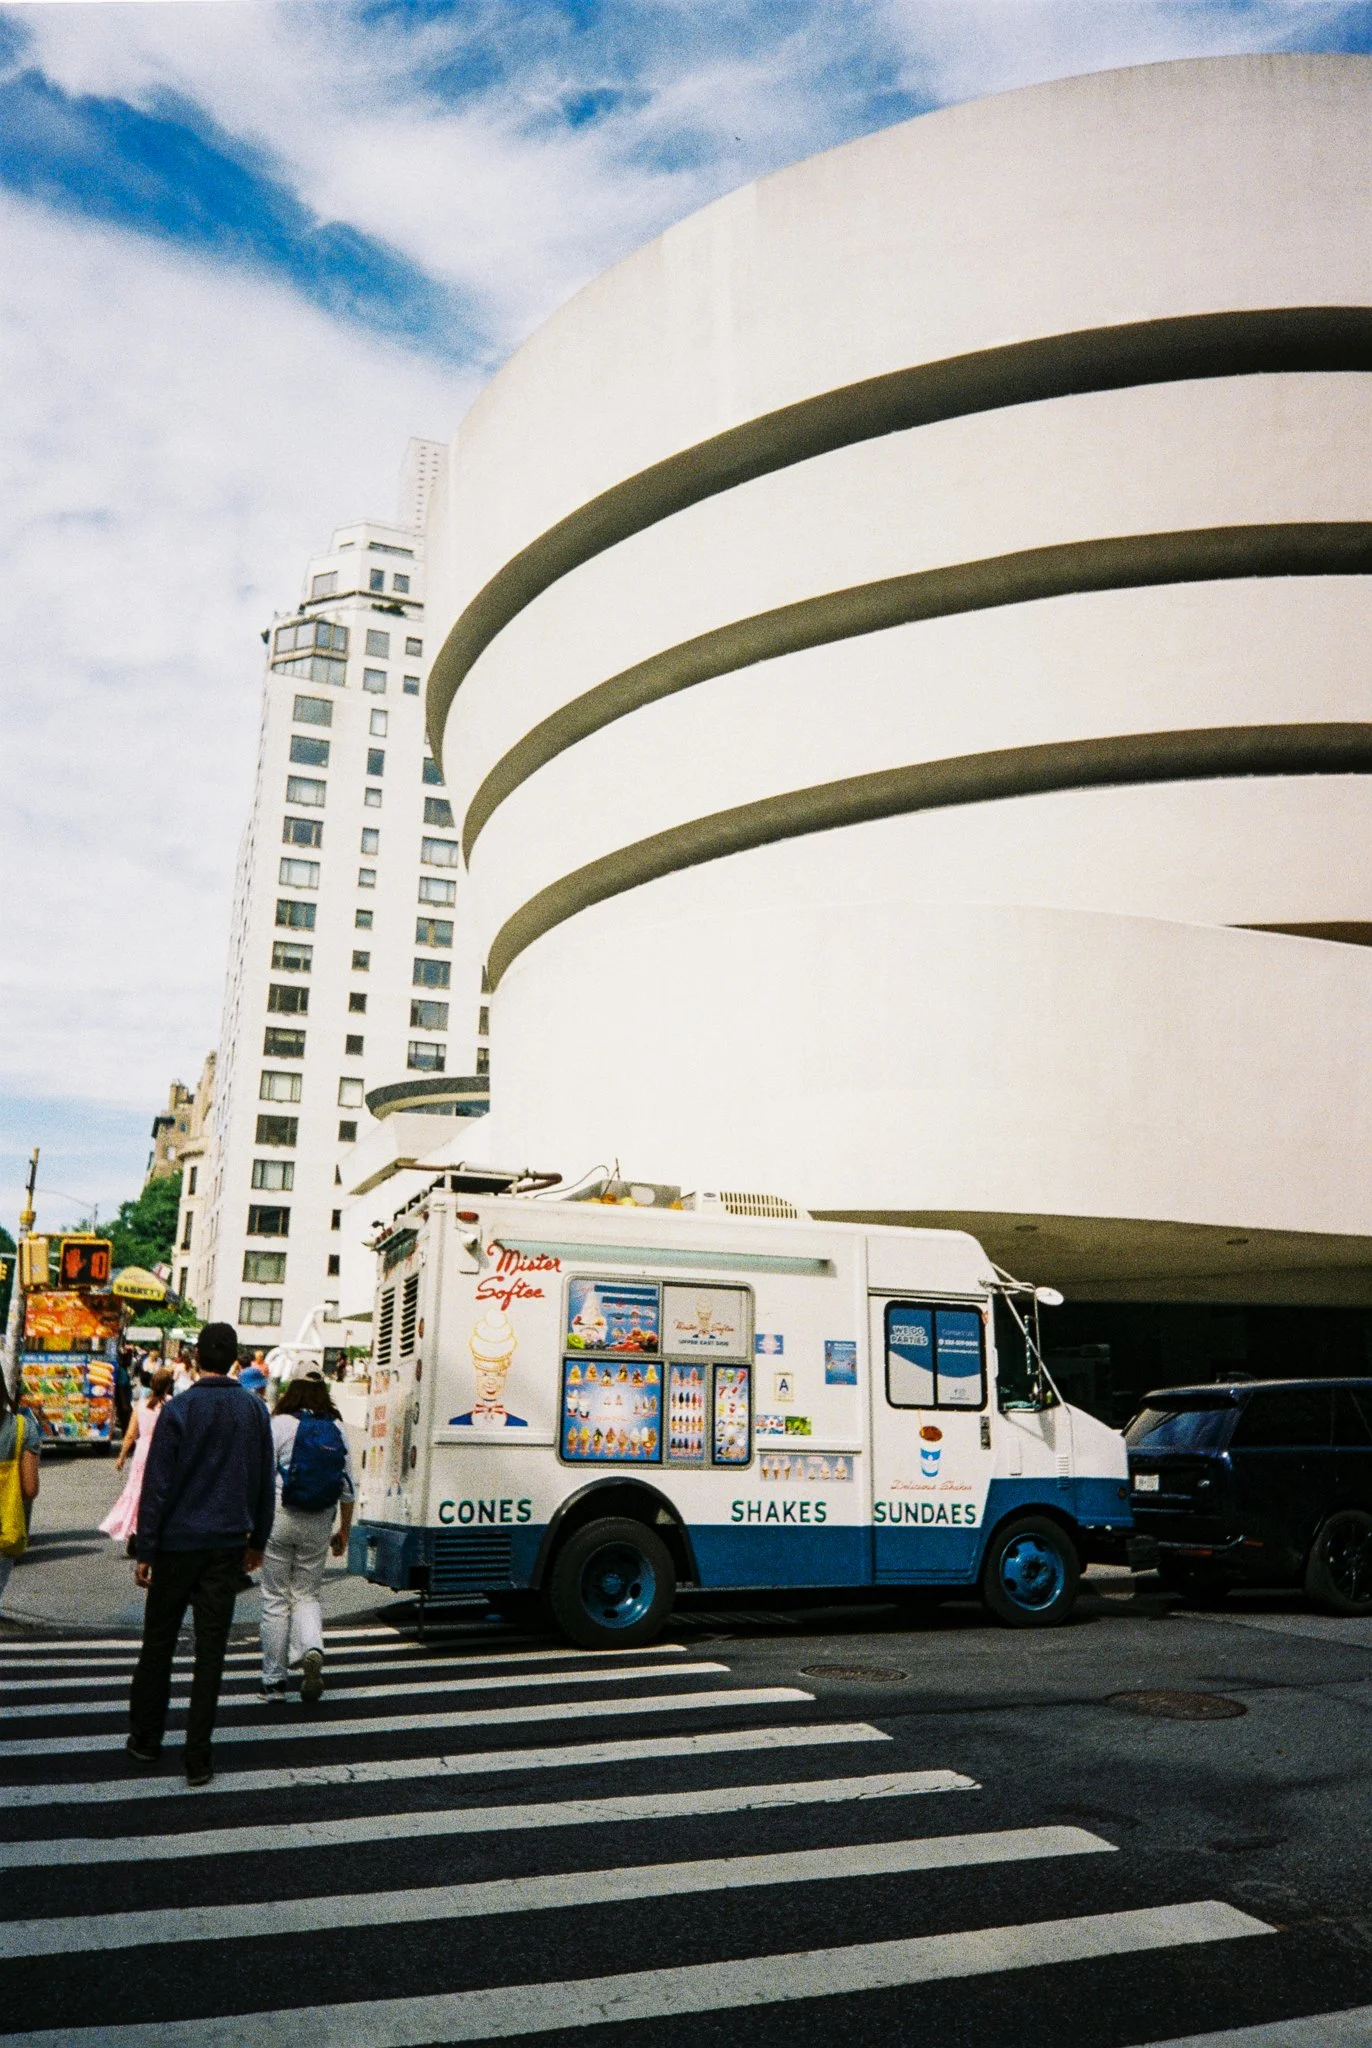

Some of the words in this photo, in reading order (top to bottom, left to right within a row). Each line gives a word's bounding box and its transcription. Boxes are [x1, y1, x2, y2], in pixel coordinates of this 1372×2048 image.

[487, 1240, 561, 1276] Mister
[475, 1276, 545, 1311] Softee
[890, 1334, 928, 1346] PARTIES
[893, 1326, 910, 1334] WE
[911, 1327, 925, 1335] DO
[779, 1378, 789, 1391] A
[438, 1498, 532, 1524] CONES
[731, 1500, 827, 1523] SHAKES
[873, 1501, 976, 1525] SUNDAES
